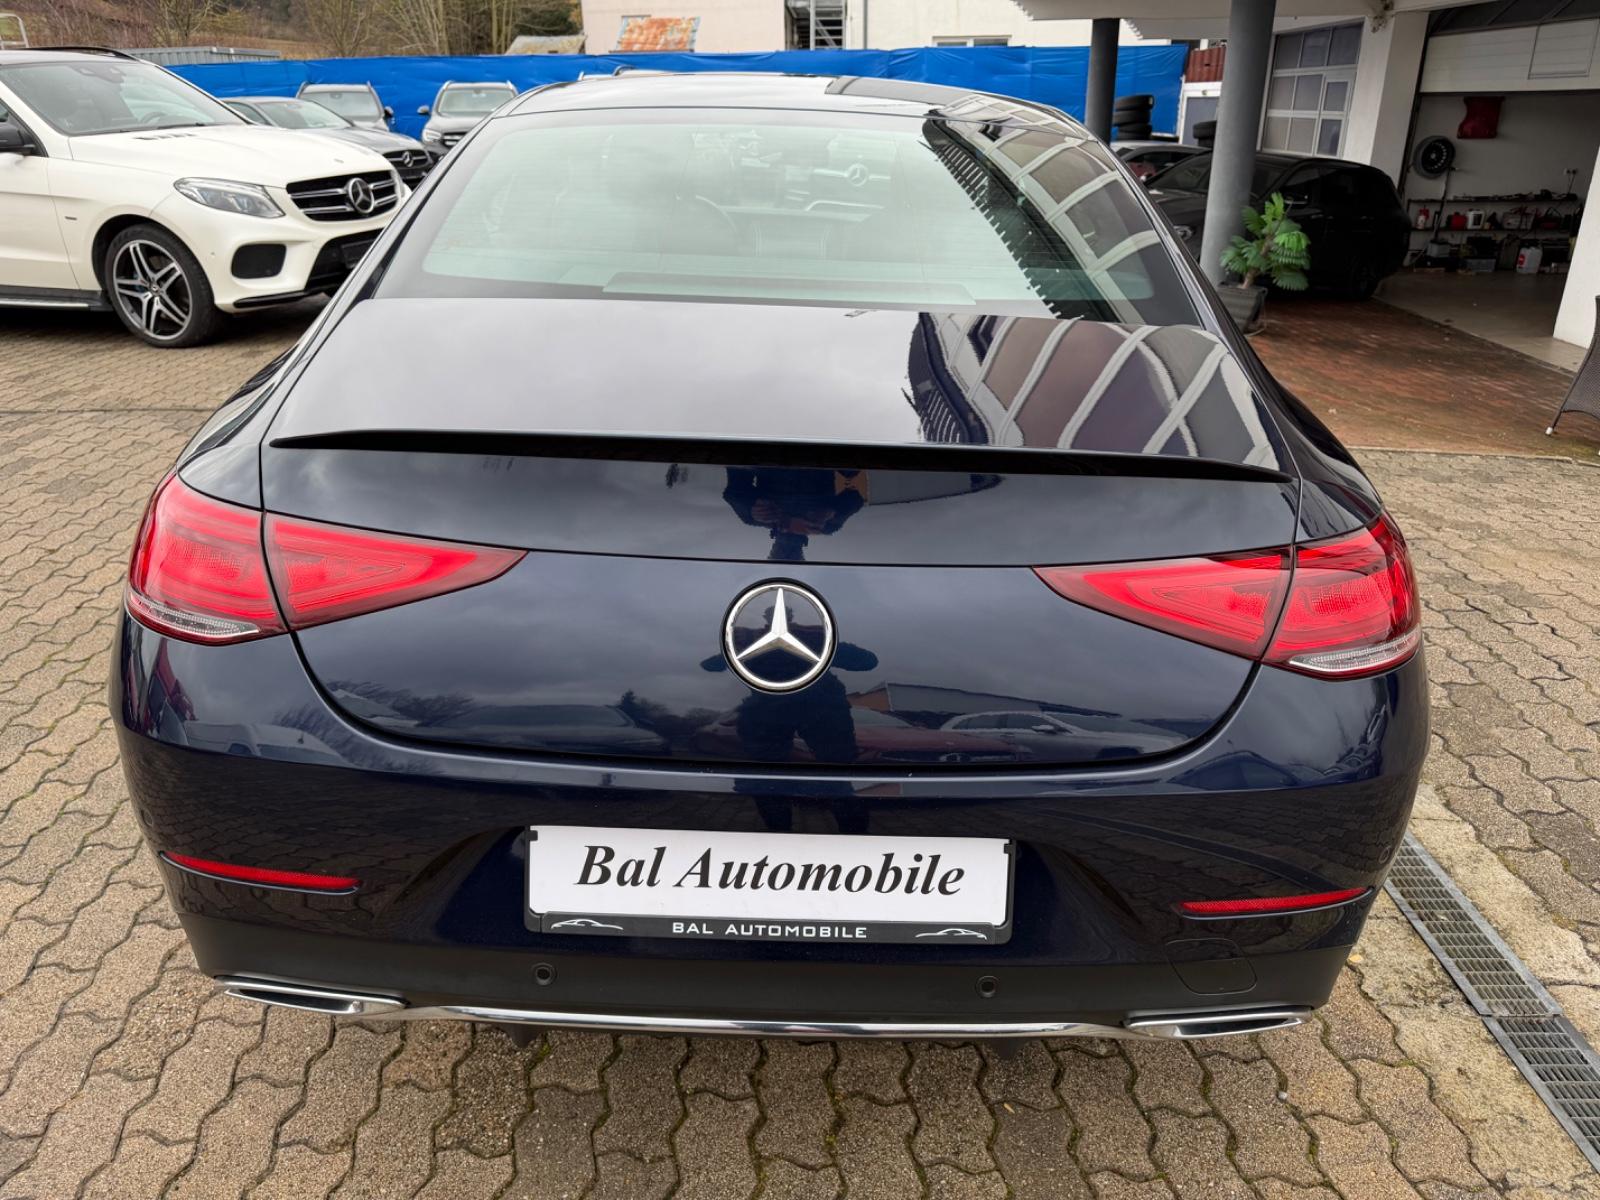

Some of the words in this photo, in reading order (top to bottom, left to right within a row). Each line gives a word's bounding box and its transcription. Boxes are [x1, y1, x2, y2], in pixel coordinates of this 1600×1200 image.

[576, 845, 666, 888] Bal
[674, 847, 965, 896] Automobile
[672, 921, 714, 935] BAL
[724, 923, 868, 939] AUTOMOBILE
